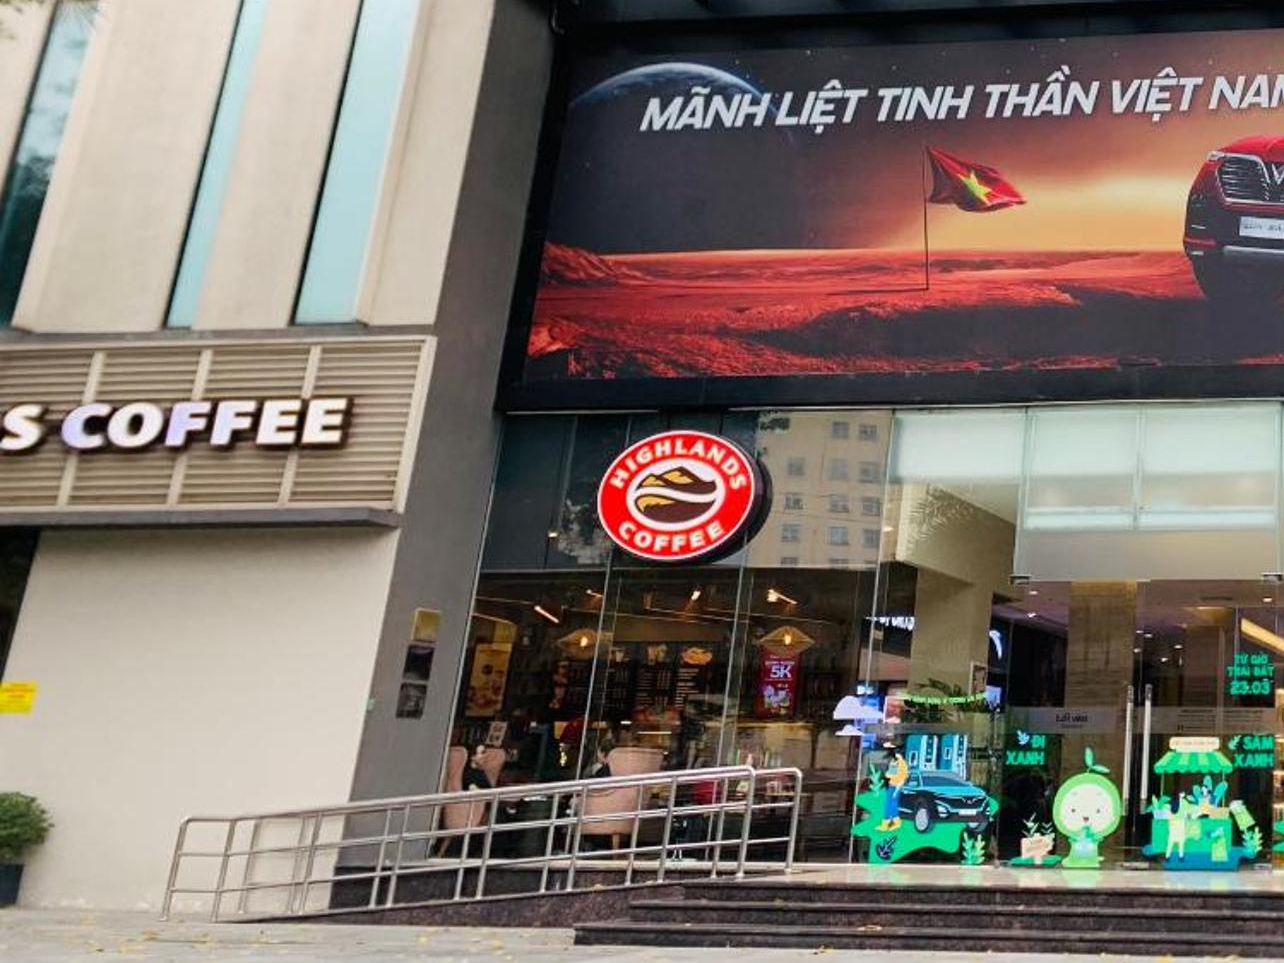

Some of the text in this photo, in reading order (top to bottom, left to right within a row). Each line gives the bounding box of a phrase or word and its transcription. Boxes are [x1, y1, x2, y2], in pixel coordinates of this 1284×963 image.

[639, 86, 769, 132] MÃNH
[776, 79, 867, 134] LIỆT
[874, 85, 973, 121] TINH
[984, 65, 1098, 119] THẦN
[1111, 66, 1202, 124] VIỆT
[61, 397, 350, 450] COFFEE
[609, 439, 747, 490] HIGHLANDS
[618, 519, 726, 553] COFFEE
[769, 664, 792, 678] 5K
[1230, 680, 1271, 695] 23.03
[1005, 750, 1045, 766] XANH
